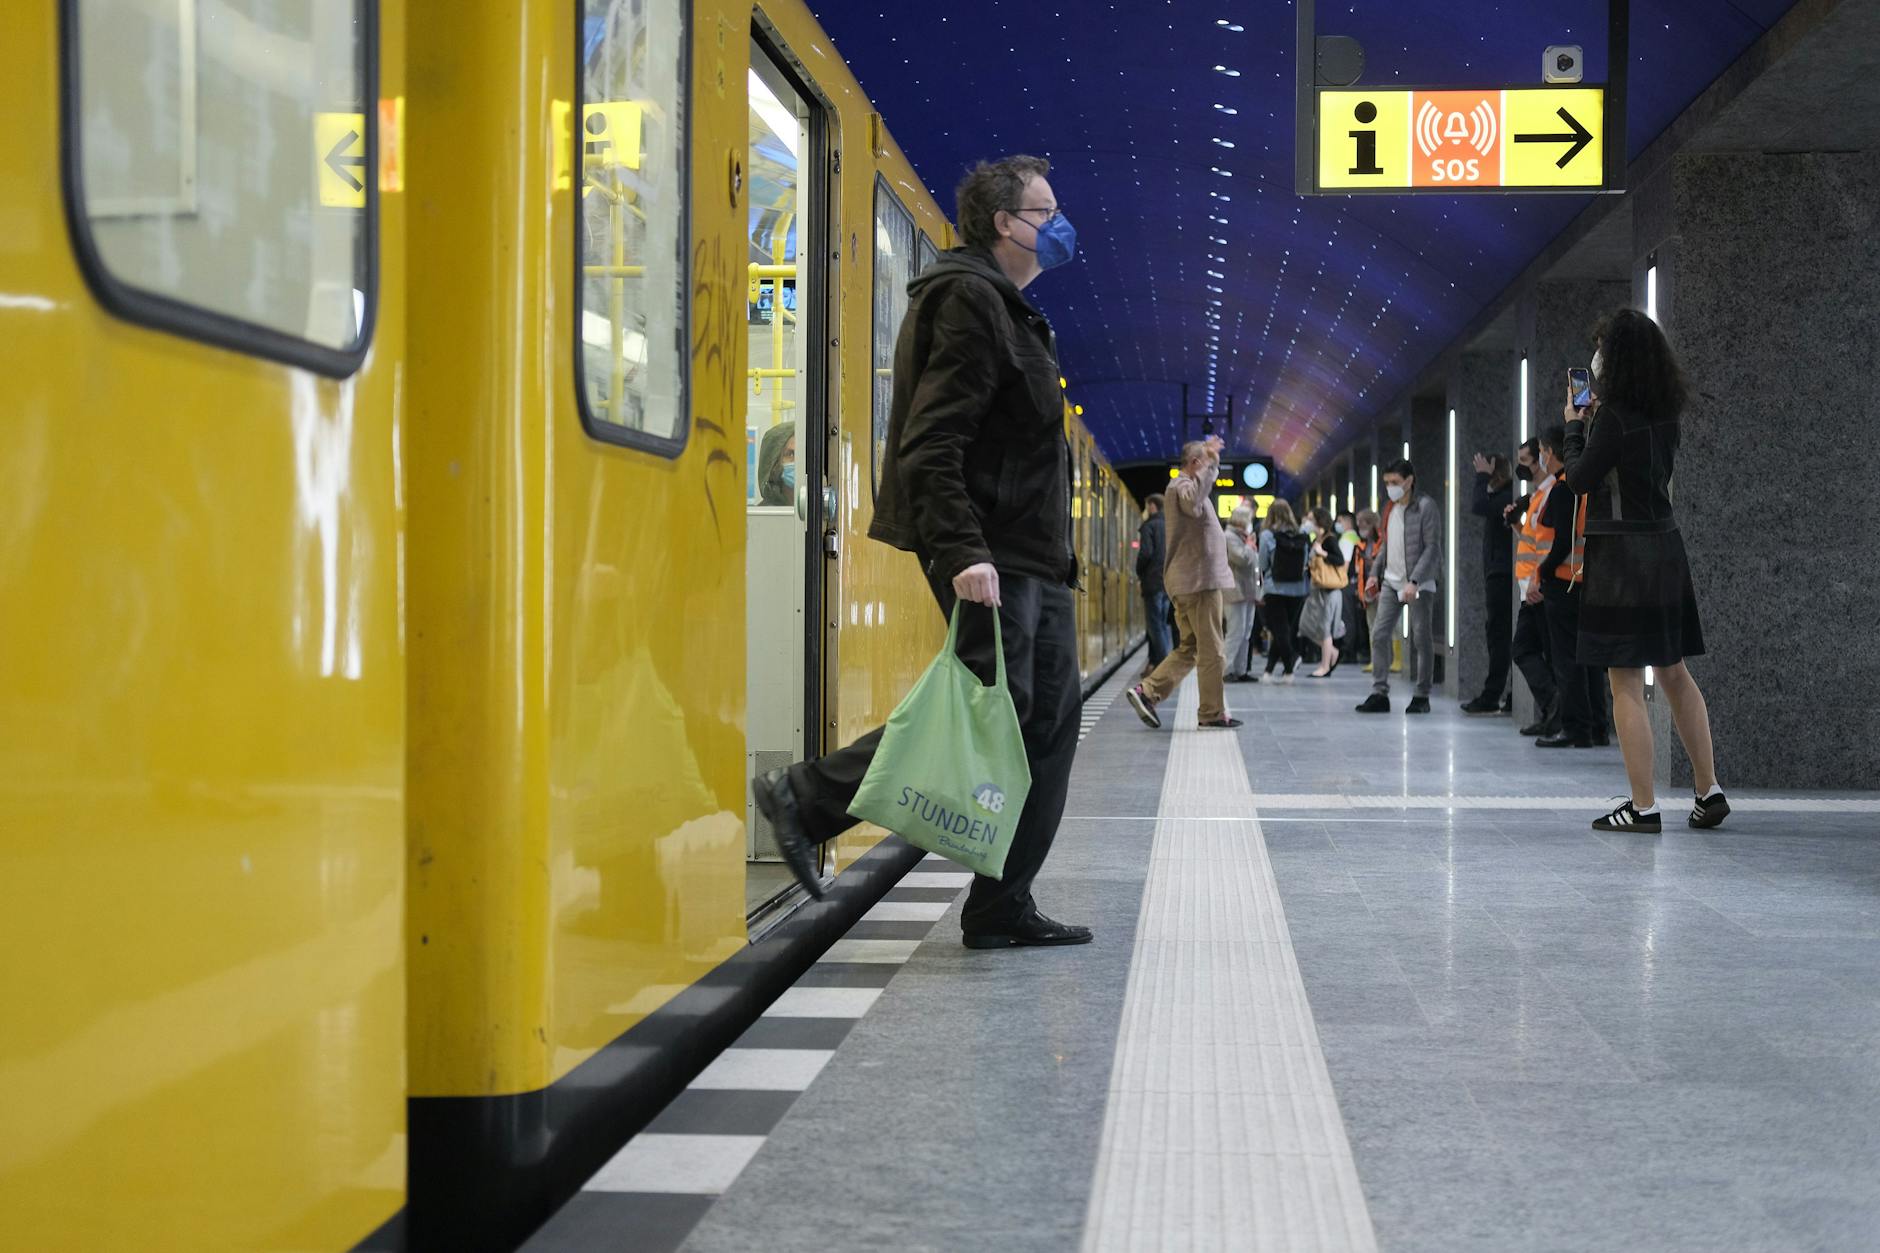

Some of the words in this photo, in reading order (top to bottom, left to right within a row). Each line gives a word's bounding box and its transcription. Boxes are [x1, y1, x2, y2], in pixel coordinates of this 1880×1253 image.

[1431, 158, 1480, 181] SOS
[976, 788, 1006, 814] 48
[897, 786, 998, 845] STUNDEN
